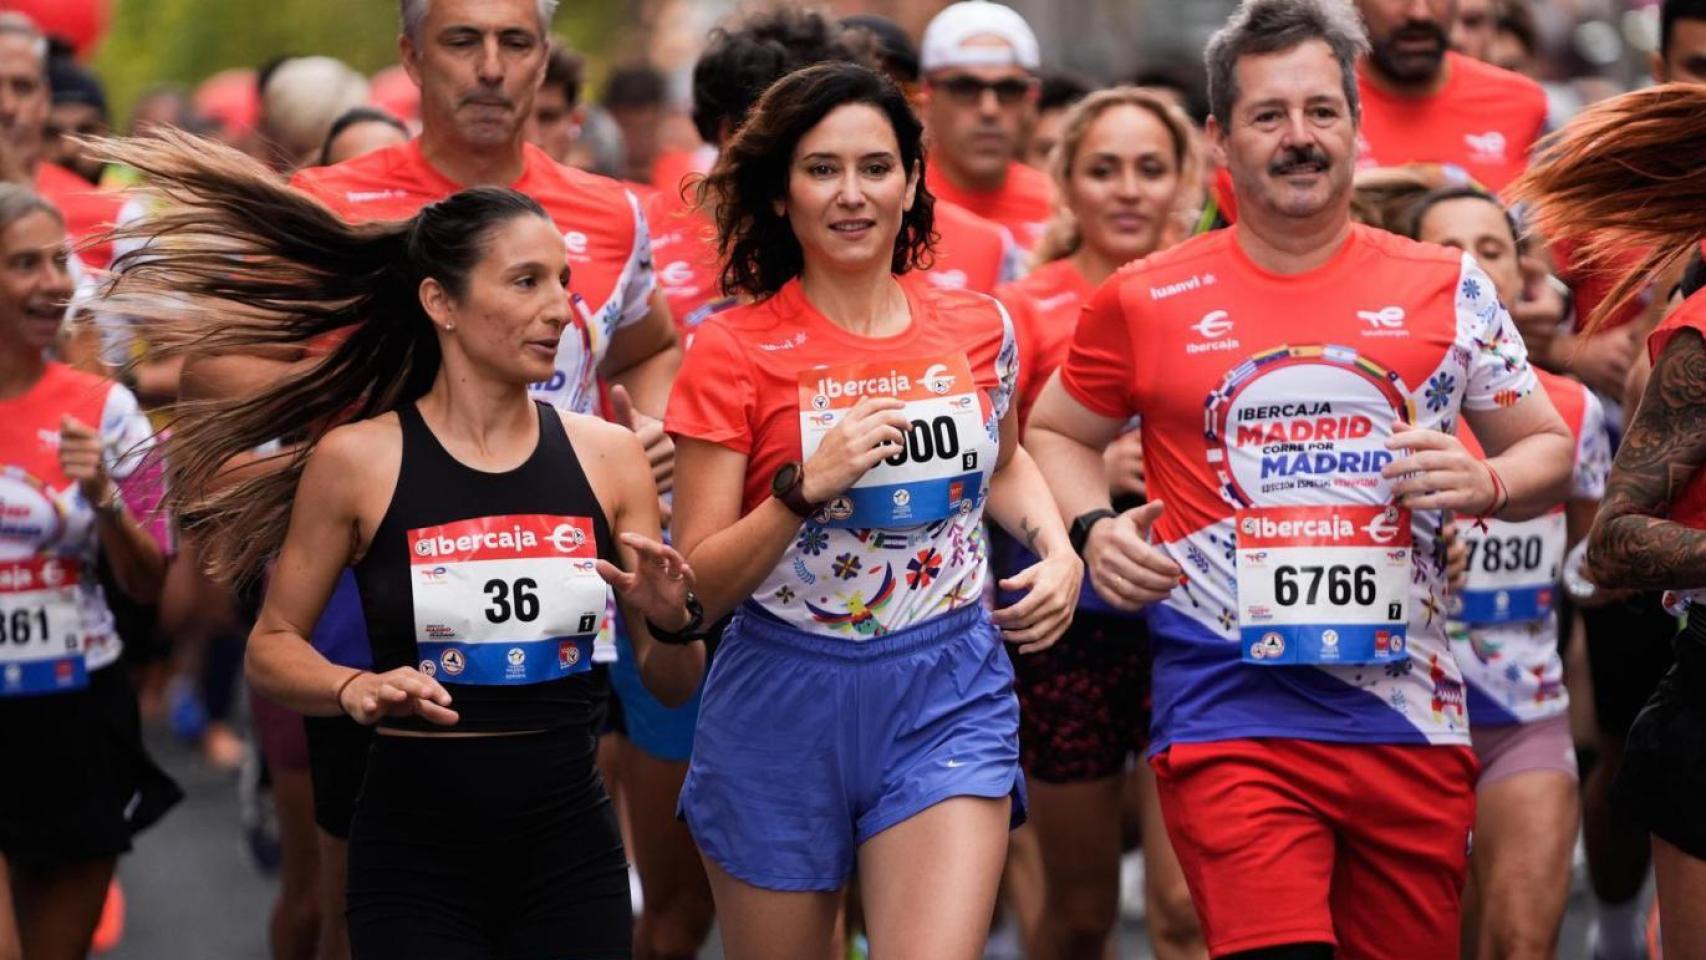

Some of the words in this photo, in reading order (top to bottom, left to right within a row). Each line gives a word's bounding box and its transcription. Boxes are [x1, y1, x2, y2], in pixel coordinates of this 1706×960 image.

[817, 370, 911, 398] Ibercaja
[1237, 402, 1332, 421] IBERCAJA
[1236, 415, 1373, 448] MADRID
[966, 454, 974, 468] 9
[1262, 443, 1305, 455] CORRE
[1308, 442, 1334, 451] POR
[1260, 451, 1393, 479] MADRID
[429, 525, 537, 557] Ibercaja
[1253, 515, 1354, 540] Ibercaja
[1465, 535, 1543, 573] 7830
[1274, 564, 1376, 606] 6766
[483, 577, 540, 624] 36
